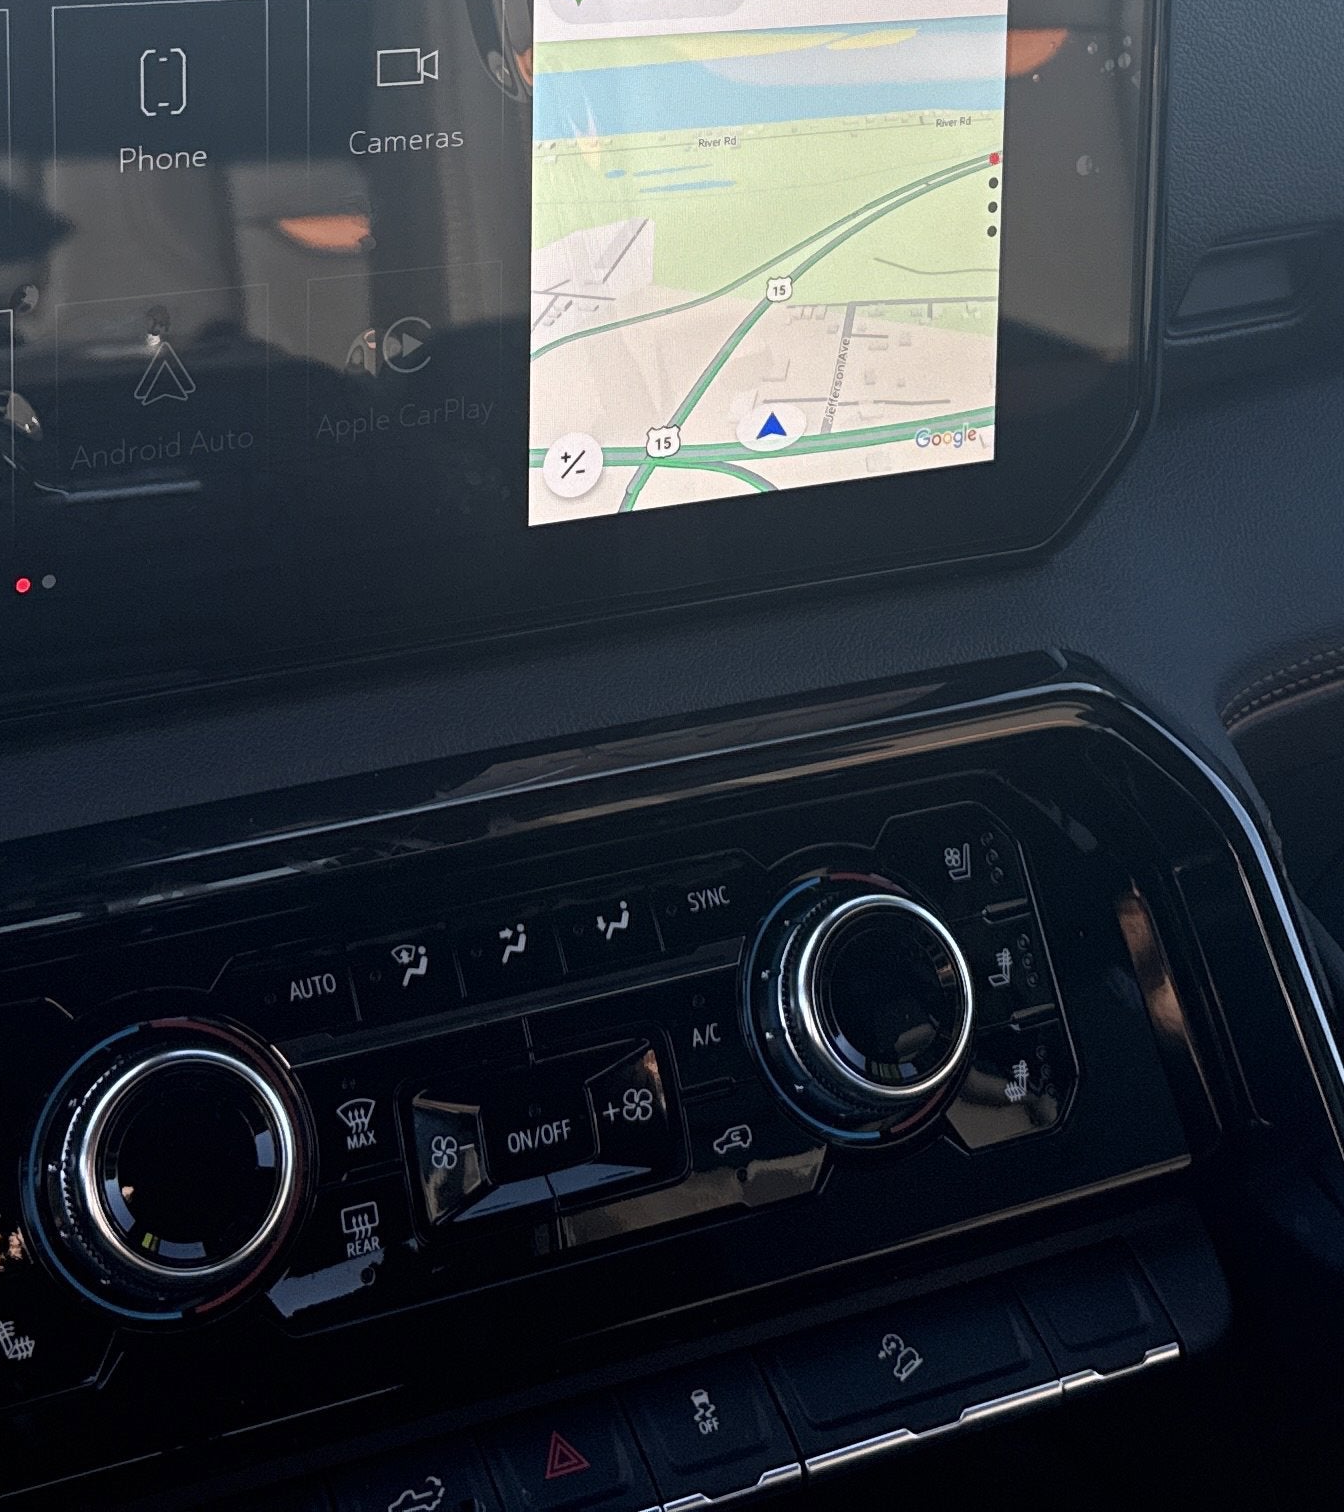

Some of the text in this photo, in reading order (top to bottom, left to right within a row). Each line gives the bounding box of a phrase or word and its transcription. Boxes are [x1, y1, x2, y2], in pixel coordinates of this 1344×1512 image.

[935, 115, 972, 129] River Rd
[348, 128, 464, 157] Cameras
[698, 134, 737, 149] River Rd
[119, 145, 208, 173] Phone
[772, 283, 787, 297] 15
[317, 398, 495, 441] Apple CarPlay
[71, 426, 255, 469] Android Auto
[654, 436, 672, 452] 15
[915, 423, 977, 450] Google
[686, 885, 731, 914] SYNC
[288, 973, 337, 1003] AUTO
[692, 1022, 722, 1049] A/C
[346, 1128, 377, 1150] MAX
[506, 1119, 572, 1154] ON/OFF
[345, 1234, 382, 1257] REAR
[698, 1416, 720, 1435] OFF
